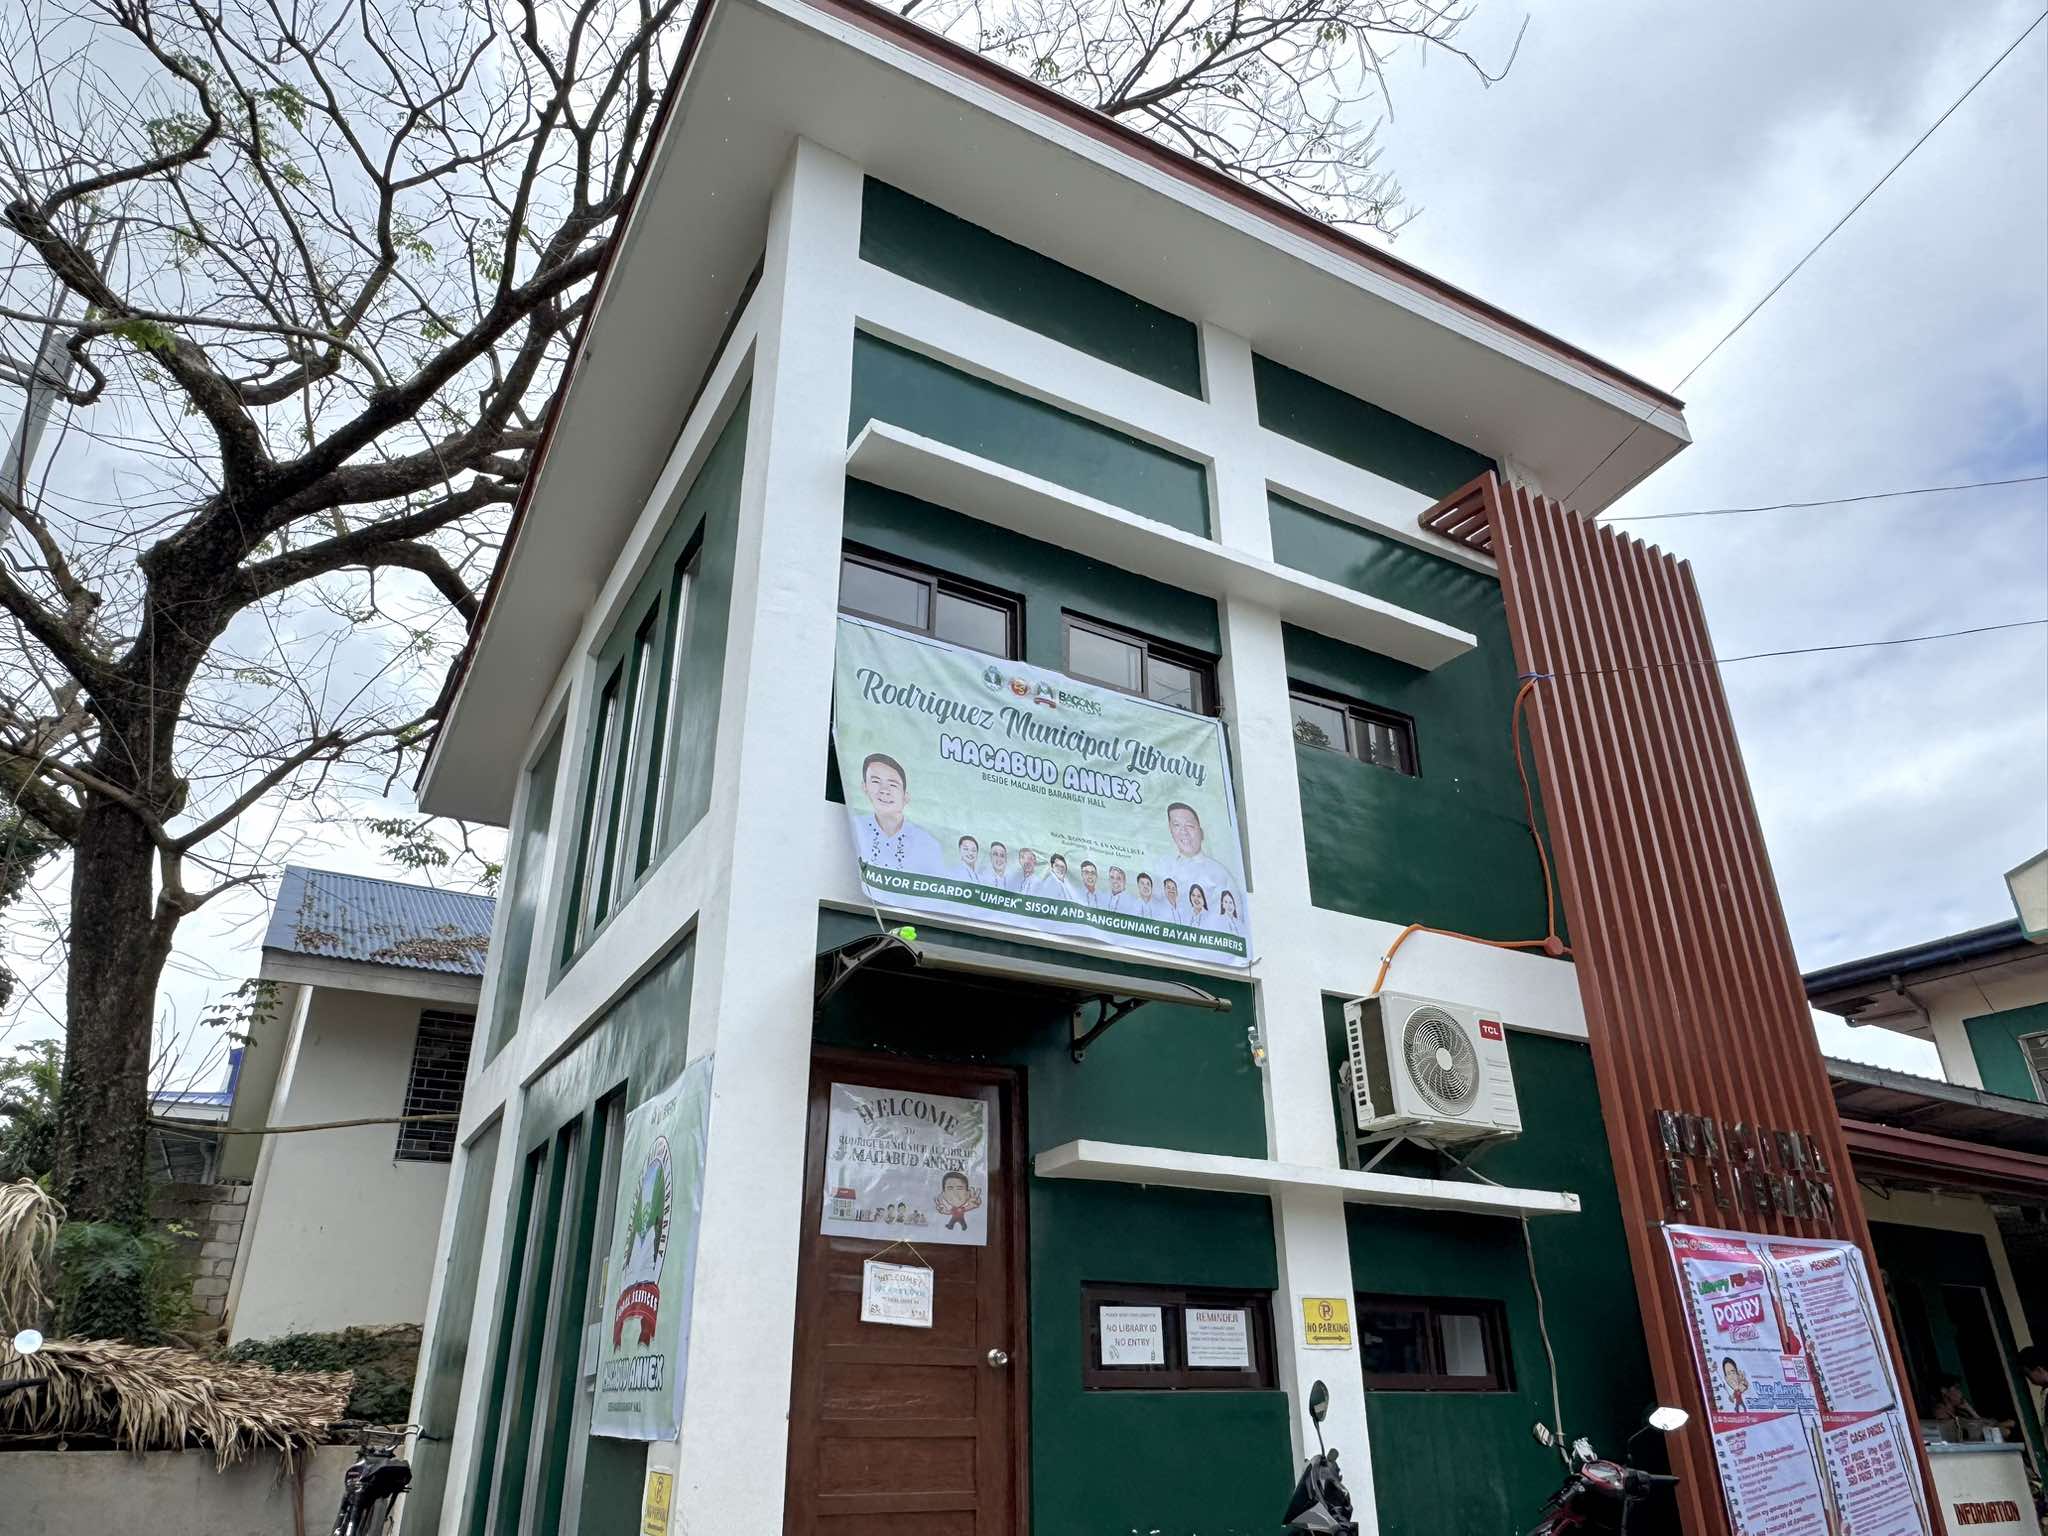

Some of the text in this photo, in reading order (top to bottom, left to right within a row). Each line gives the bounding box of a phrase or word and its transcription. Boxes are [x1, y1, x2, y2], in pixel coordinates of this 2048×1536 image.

[856, 668, 1207, 787] Rodriguez Municipal Library
[940, 733, 1142, 804] MACABUD ANNEX
[982, 772, 1009, 786] BESIDE
[1010, 777, 1047, 795] MACABUD
[1087, 797, 1107, 808] HALL
[866, 869, 1244, 952] MAYOR EDGARDO "UMPEK" SISON AND SANGGUNIANG BAYAN MEMBERS
[1482, 1025, 1499, 1035] TCL
[855, 1097, 960, 1136] WELCOME
[853, 1148, 967, 1171] MACABUD ANNEX
[1713, 1297, 1760, 1326] POETRY
[1106, 1323, 1118, 1333] NO
[1118, 1323, 1149, 1333] LIBRARY
[1114, 1337, 1150, 1346] NO ENTRY
[1307, 1322, 1349, 1333] NO PARKING
[628, 1354, 664, 1392] ANNEX
[1953, 1500, 2021, 1525] INFORMATION
